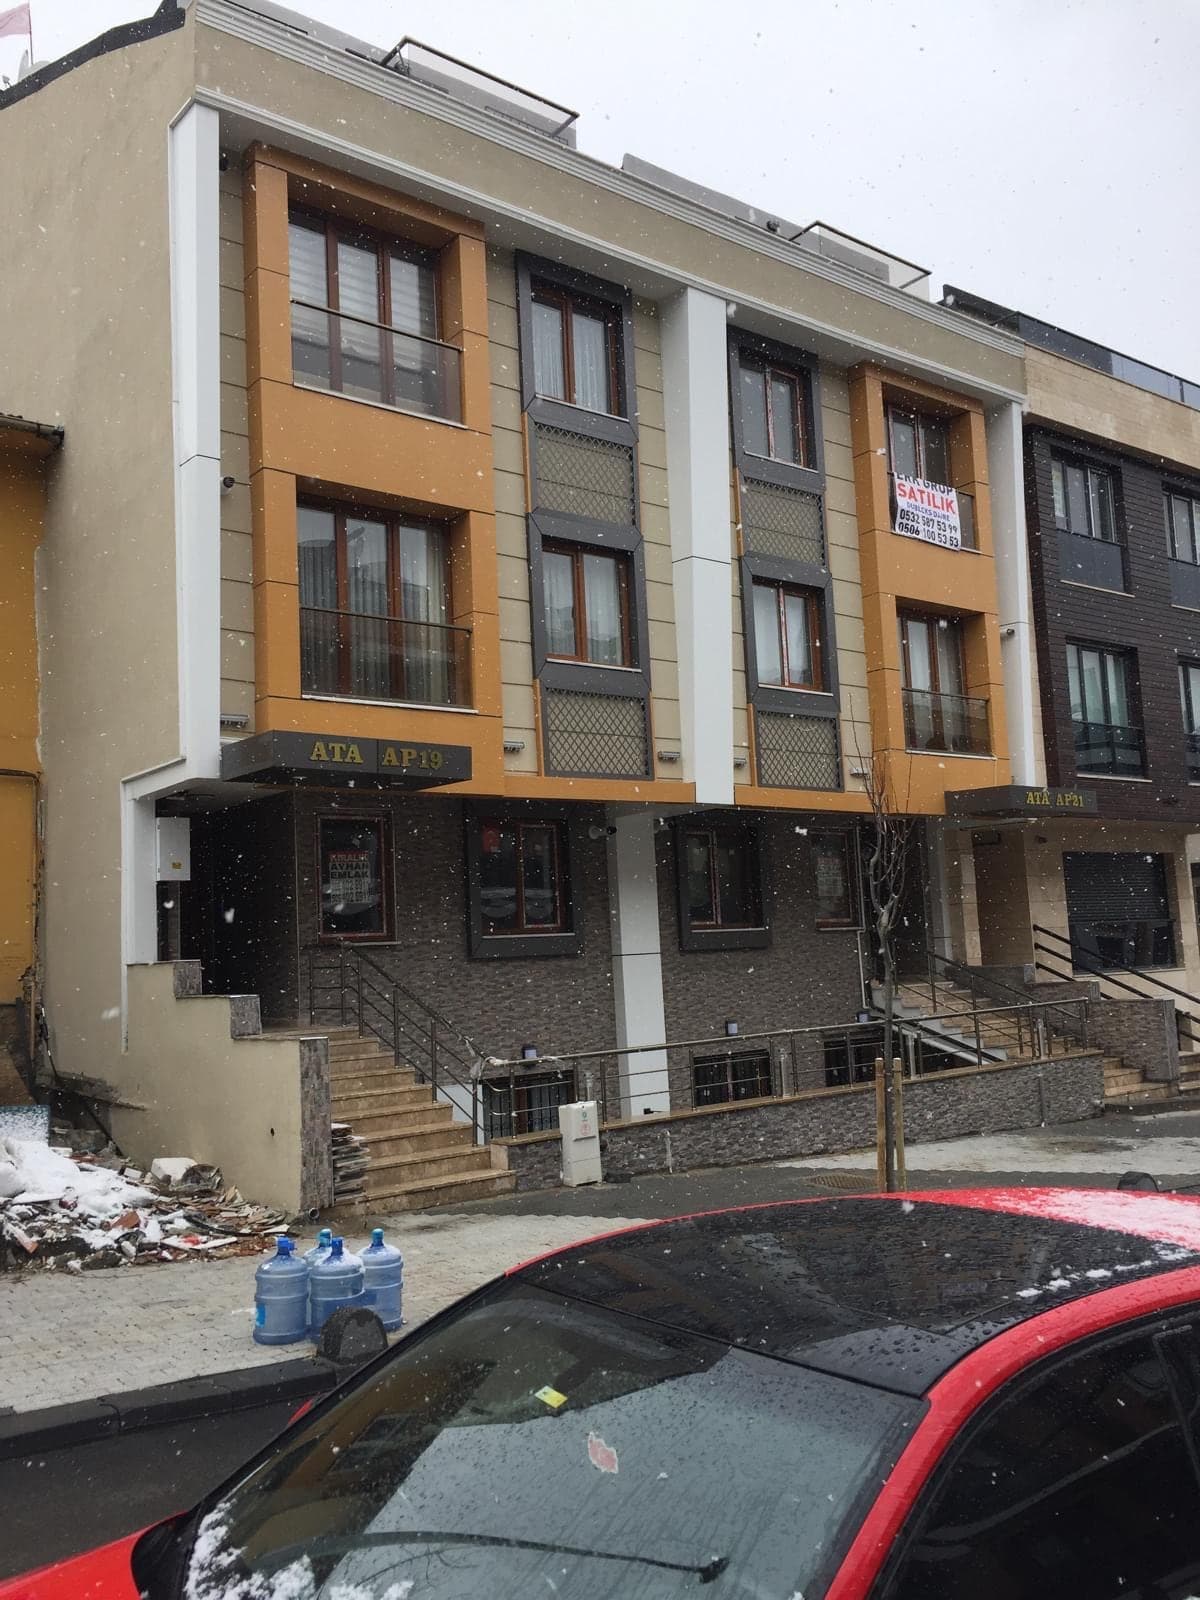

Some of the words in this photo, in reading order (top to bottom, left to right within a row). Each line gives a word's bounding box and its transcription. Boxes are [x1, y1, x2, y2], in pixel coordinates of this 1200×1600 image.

[898, 483, 955, 513] SATILIK
[900, 509, 920, 524] 0532
[937, 520, 947, 532] 53
[898, 522, 920, 536] 0506
[938, 533, 948, 544] 53
[949, 536, 959, 547] 53
[309, 741, 364, 763] ATA
[382, 747, 443, 769] AP19
[1026, 791, 1050, 805] ATA
[1056, 793, 1083, 807] AP21
[330, 870, 369, 879] EMLAK
